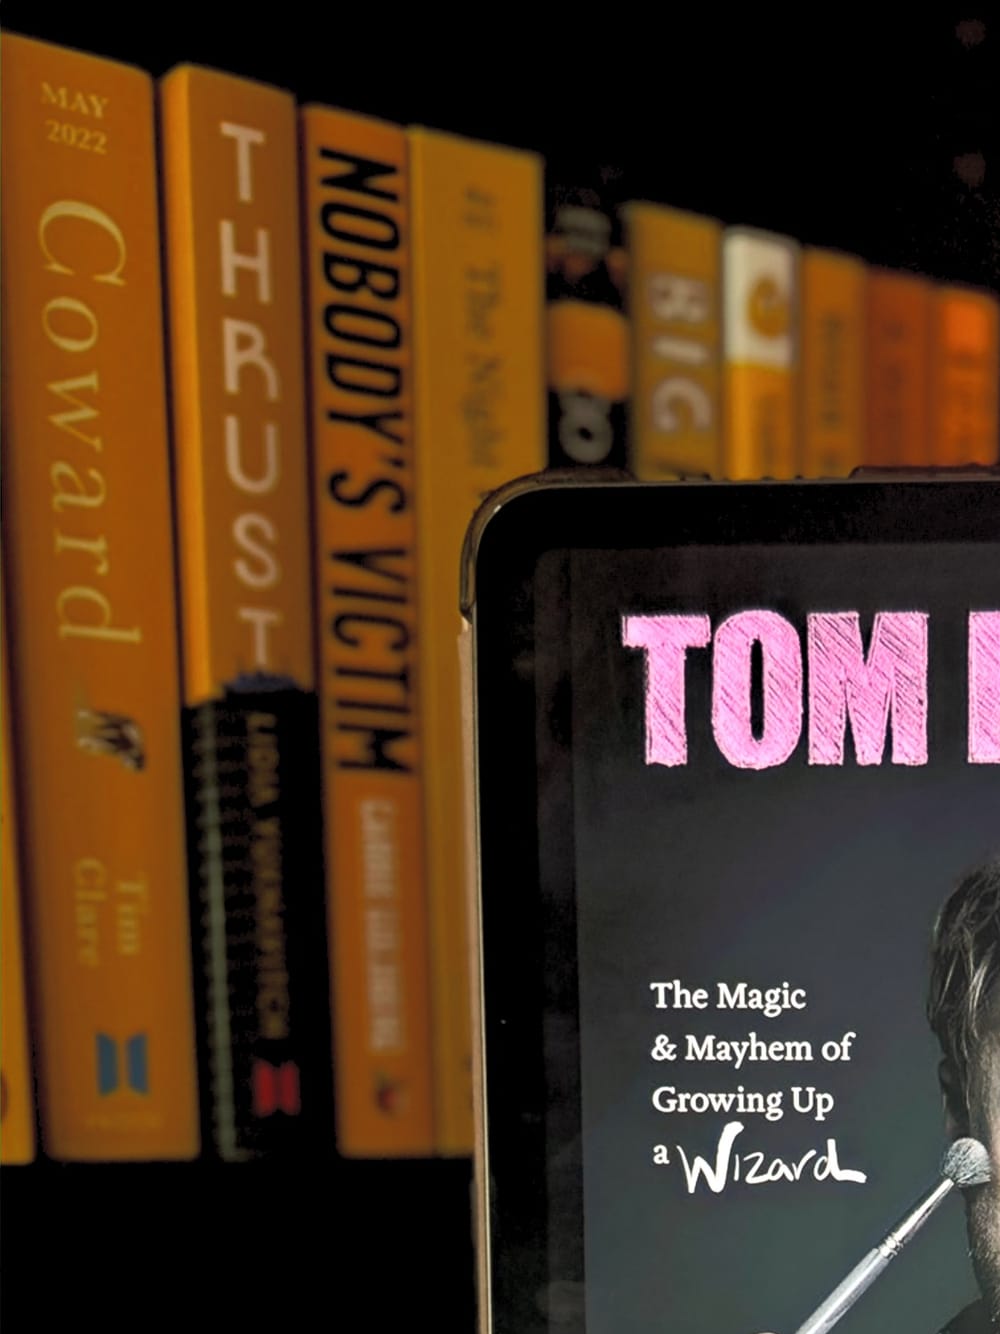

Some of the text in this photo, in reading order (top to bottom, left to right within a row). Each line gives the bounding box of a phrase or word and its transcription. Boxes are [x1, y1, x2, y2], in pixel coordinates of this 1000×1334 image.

[40, 81, 109, 119] MAY
[46, 120, 108, 155] 2022
[318, 146, 412, 516] NOBODY'S
[38, 198, 143, 645] Coward
[219, 121, 281, 665] THRUST
[327, 545, 415, 777] VICTIM
[621, 610, 930, 771] TOM
[649, 980, 807, 1018] The Magic
[650, 1031, 858, 1070] & Mayhem of
[651, 1085, 835, 1124] Growing Up
[652, 1121, 868, 1194] a Wizard
